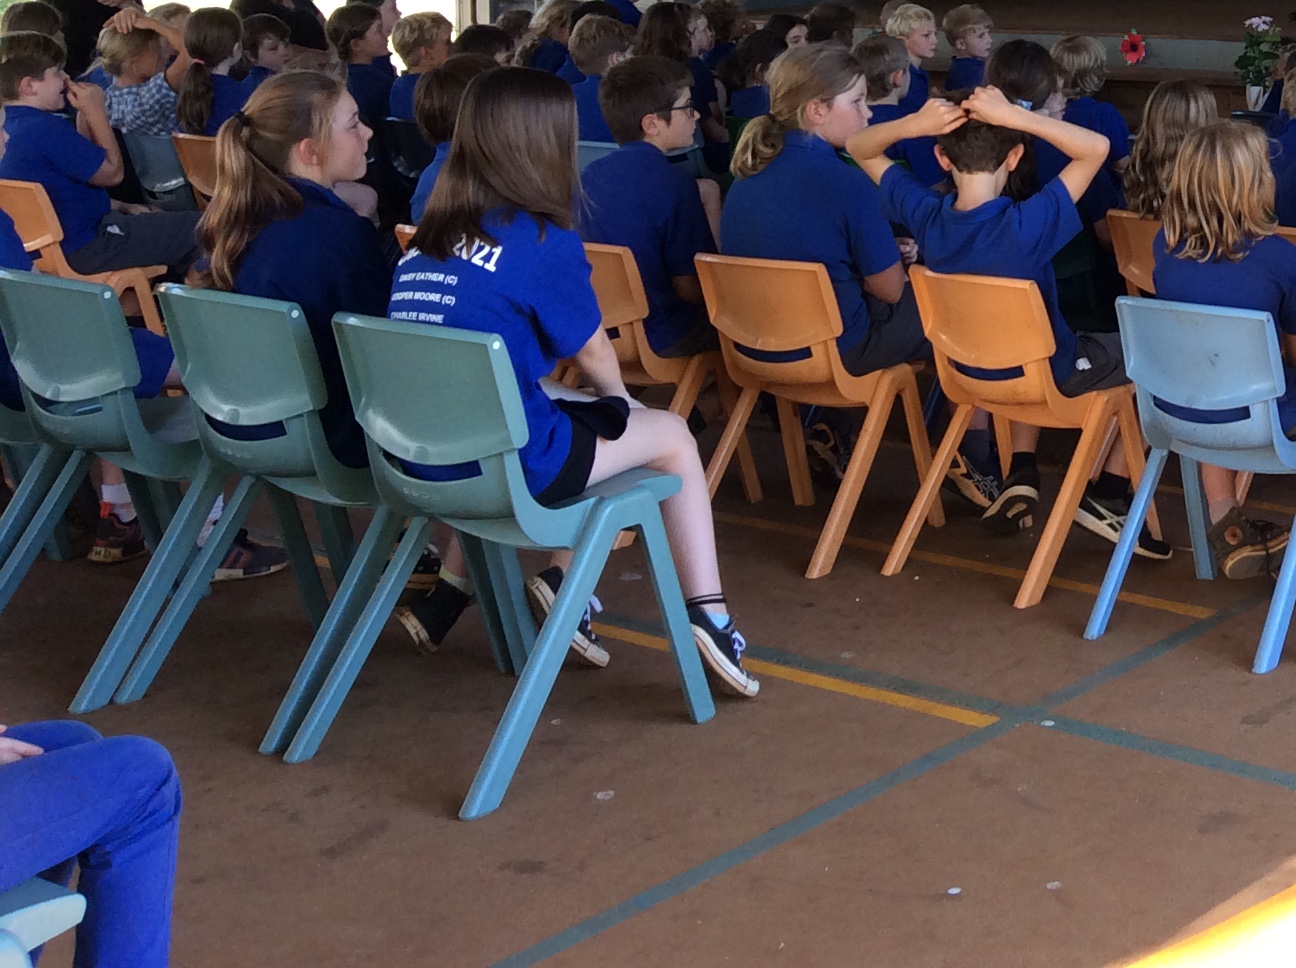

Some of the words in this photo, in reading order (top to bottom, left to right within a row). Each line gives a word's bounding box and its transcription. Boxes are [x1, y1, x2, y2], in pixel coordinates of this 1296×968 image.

[453, 233, 503, 272] 2021
[444, 275, 458, 286] (C)
[413, 292, 441, 303] MOORE
[442, 295, 456, 306] (C)
